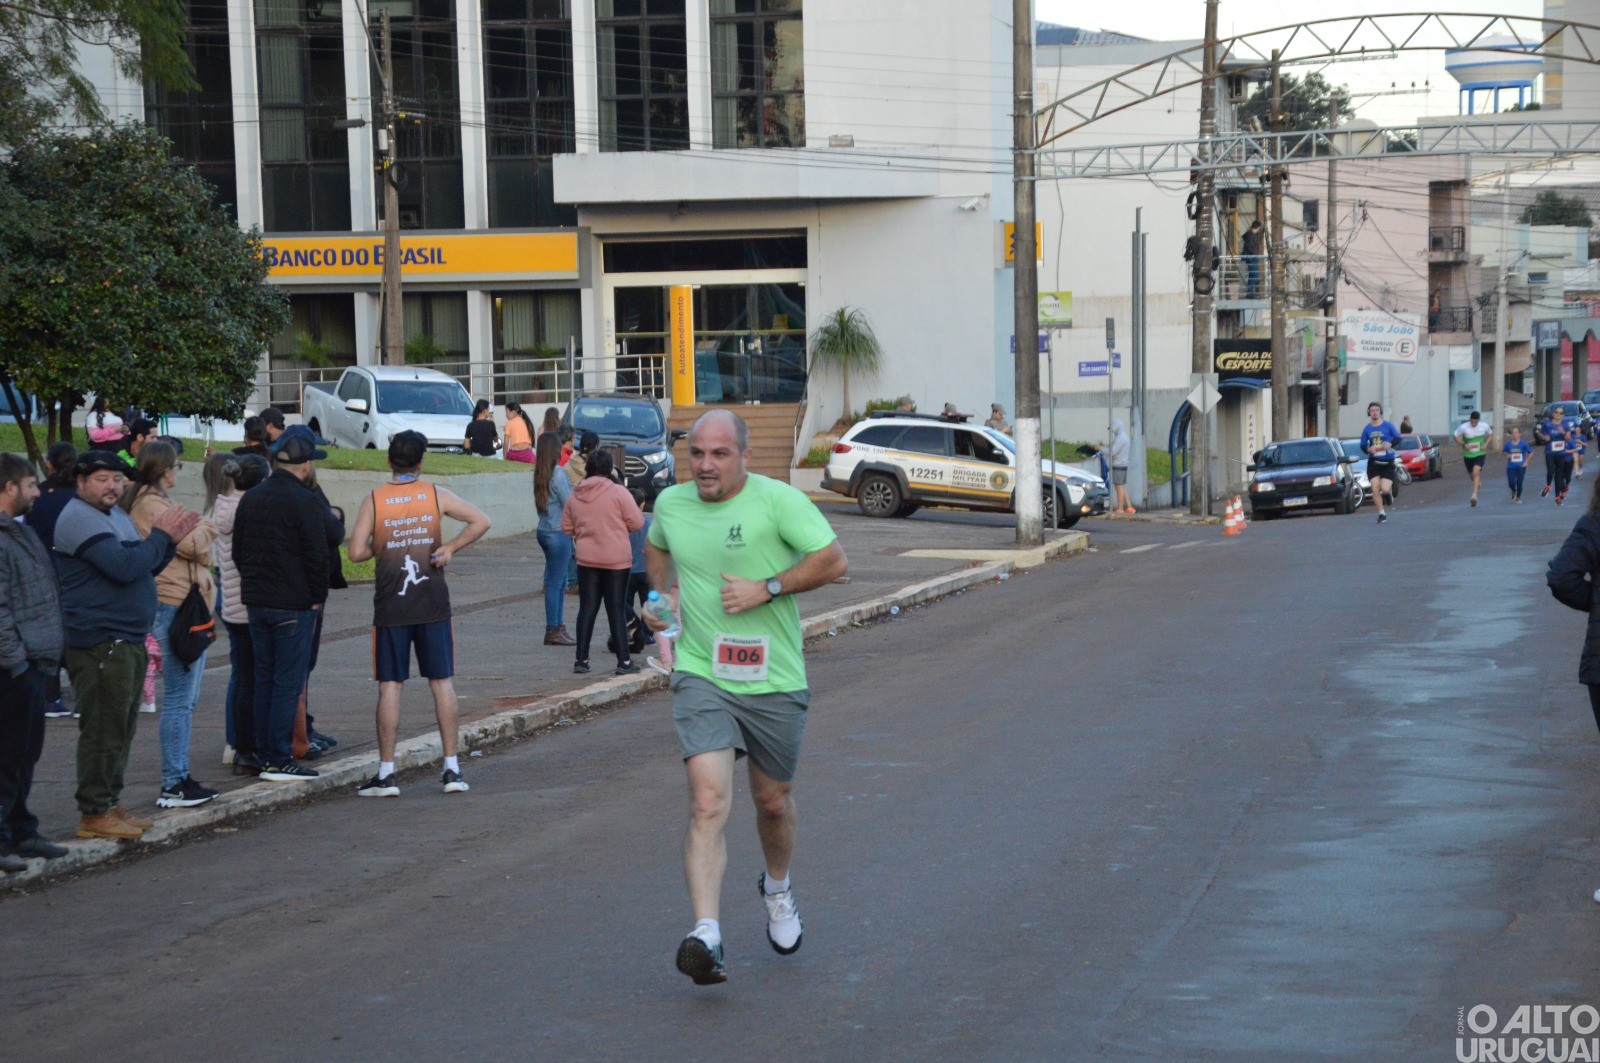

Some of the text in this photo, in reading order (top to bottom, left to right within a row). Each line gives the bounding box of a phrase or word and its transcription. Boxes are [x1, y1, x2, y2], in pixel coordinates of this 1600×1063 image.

[263, 246, 337, 267] BANCO
[341, 248, 369, 266] DO
[1363, 321, 1414, 335] São João
[677, 295, 686, 375] Autoatendimento
[1361, 339, 1393, 347] EXCLUSIVO
[1400, 342, 1410, 353] E
[1236, 351, 1259, 359] LOJA
[852, 445, 871, 453] FONE
[909, 467, 944, 481] 12251
[953, 468, 987, 478] BRIGADA
[952, 475, 986, 484] MILITAR
[385, 496, 412, 505] SEBERI
[384, 513, 433, 527] Equipe de
[393, 526, 428, 537] Corrida
[386, 537, 434, 549] Med Forma
[726, 647, 760, 663] 106
